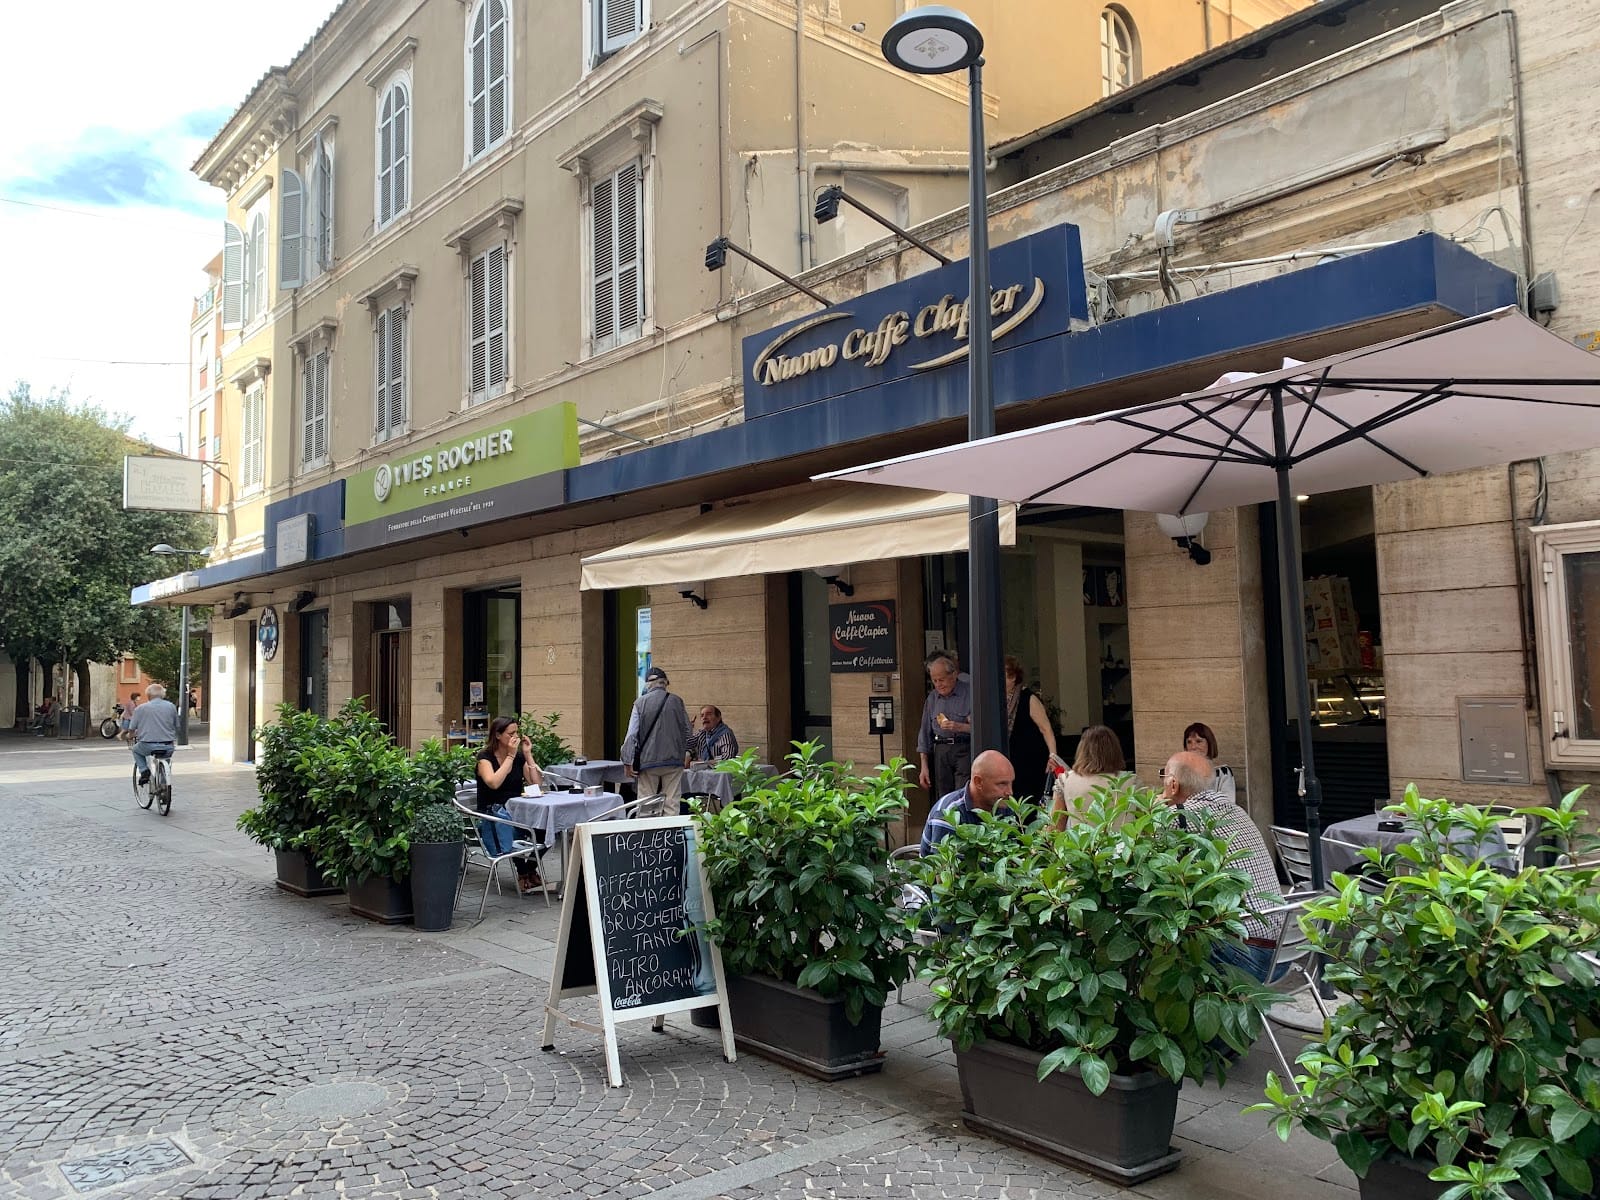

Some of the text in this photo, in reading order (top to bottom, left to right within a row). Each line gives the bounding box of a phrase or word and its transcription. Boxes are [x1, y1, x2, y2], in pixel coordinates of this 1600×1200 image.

[761, 344, 838, 386] Nuovo
[393, 429, 513, 486] YVES ROCHER
[424, 476, 471, 497] FRANCE
[846, 610, 875, 624] Nuovo
[859, 656, 893, 667] Caffetteria
[605, 829, 685, 855] TAGLIERE
[603, 885, 681, 916] FORMAGGI
[603, 904, 684, 935] BRUSCHETTE
[632, 927, 682, 952] TANTO
[612, 953, 659, 981] ALTRO
